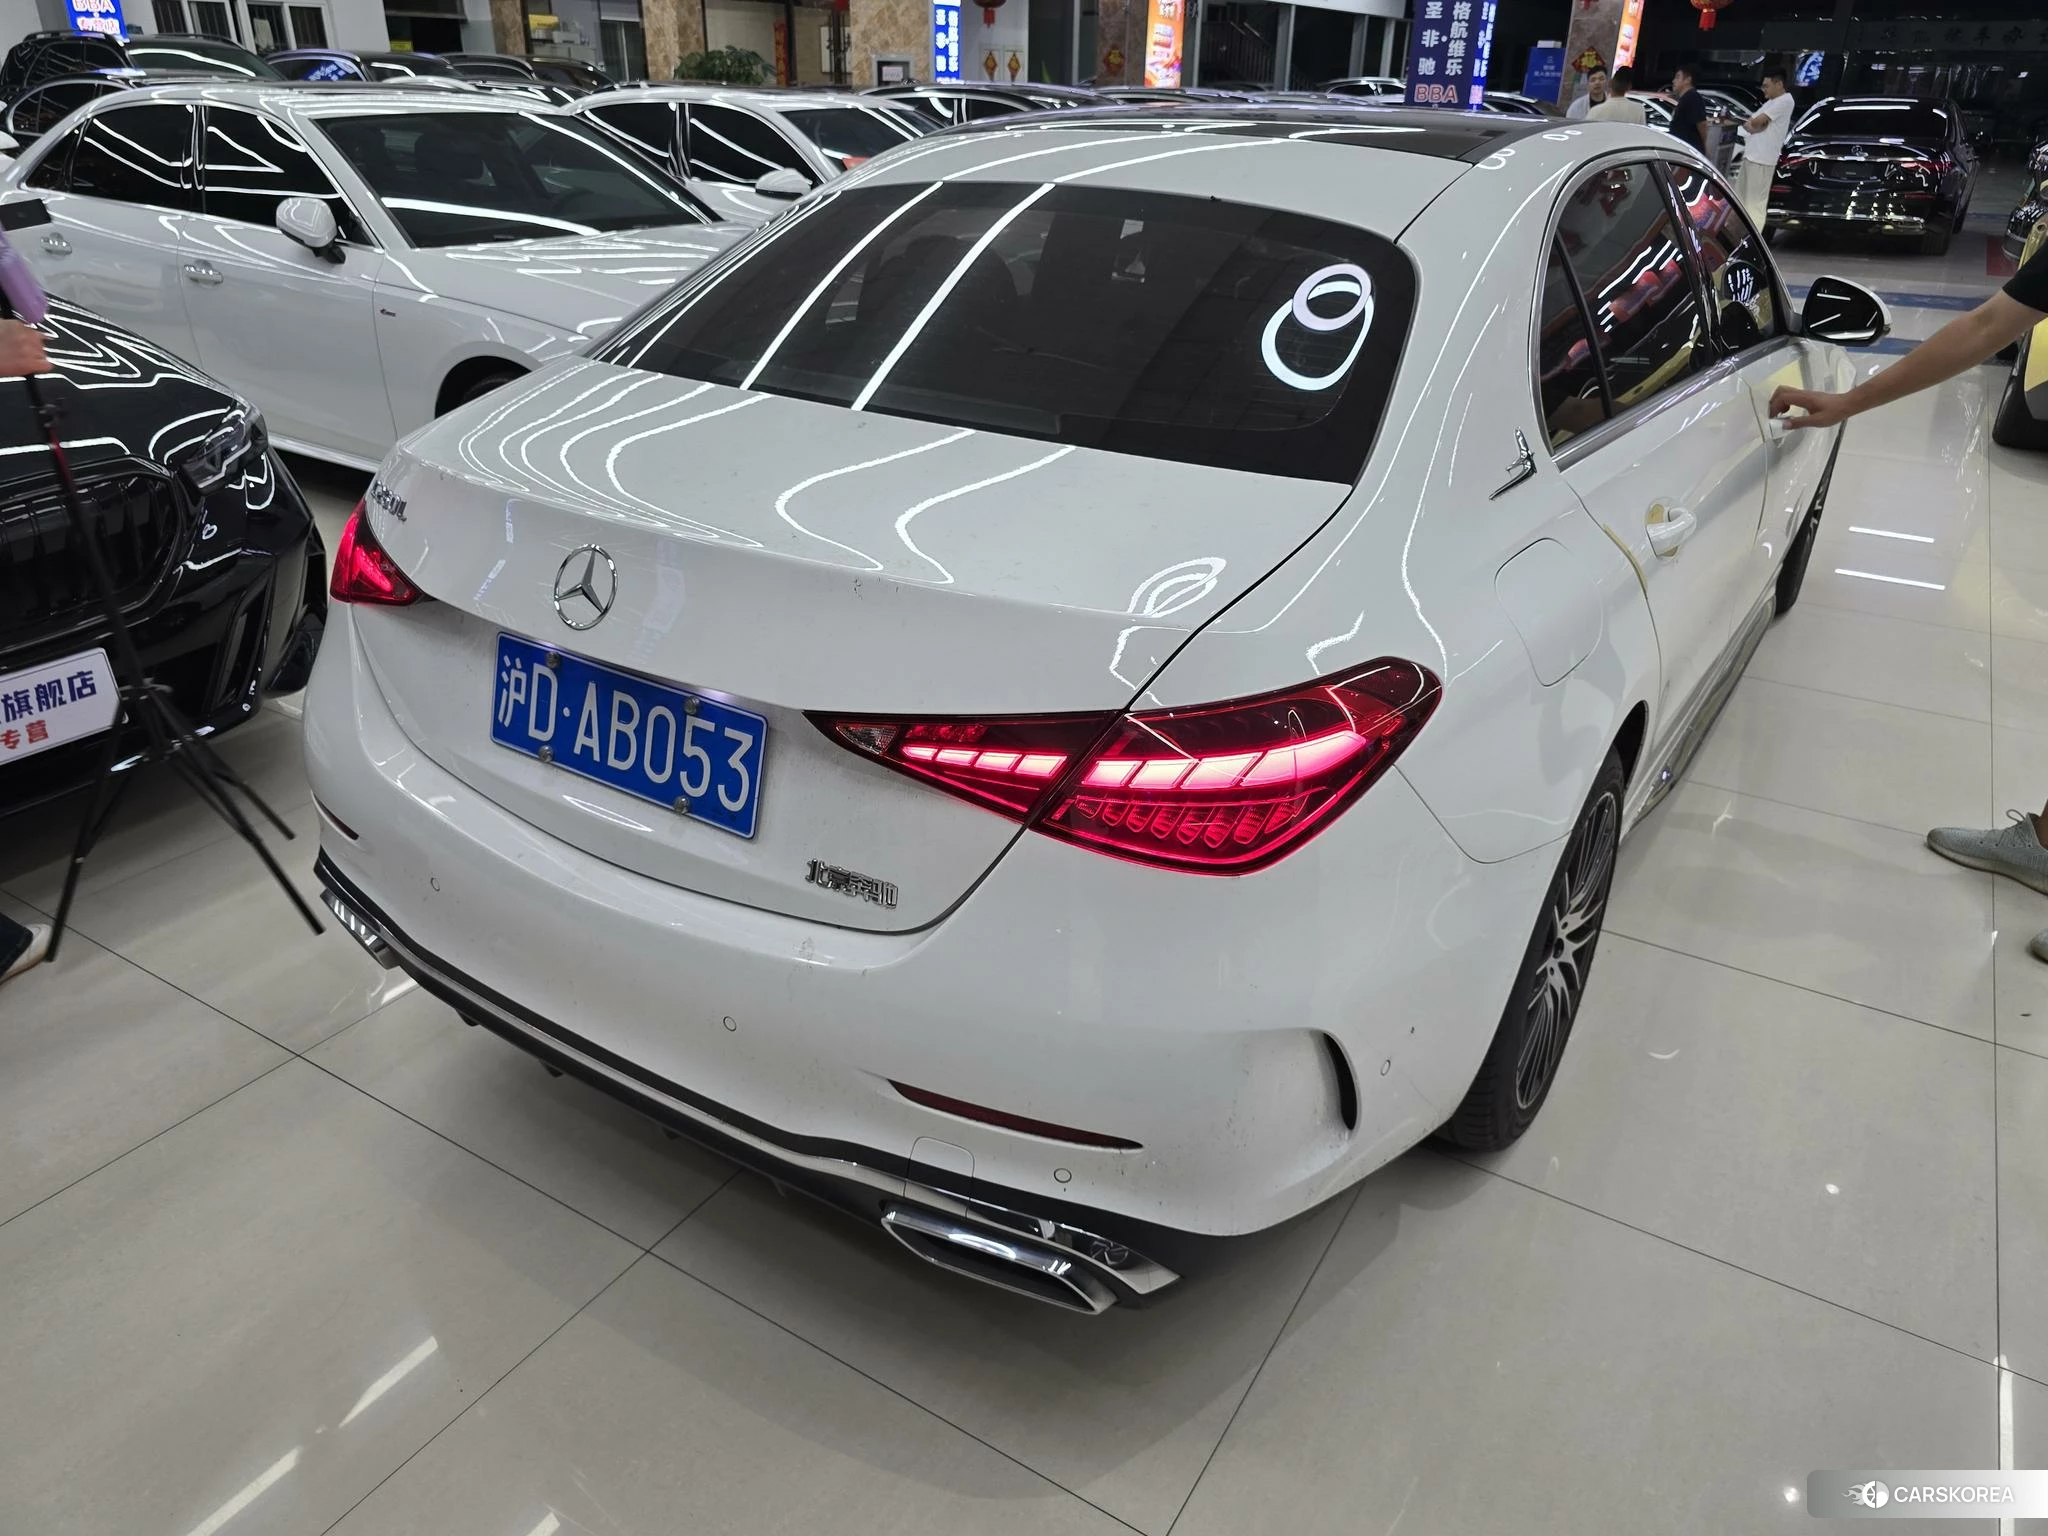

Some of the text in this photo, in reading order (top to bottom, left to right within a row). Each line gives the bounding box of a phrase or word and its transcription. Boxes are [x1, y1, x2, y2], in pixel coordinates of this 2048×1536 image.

[1445, 2, 1471, 76] 格航维乐
[1414, 84, 1458, 103] BBA
[0, 719, 48, 750] 专营
[805, 858, 898, 909] 北京奔驰
